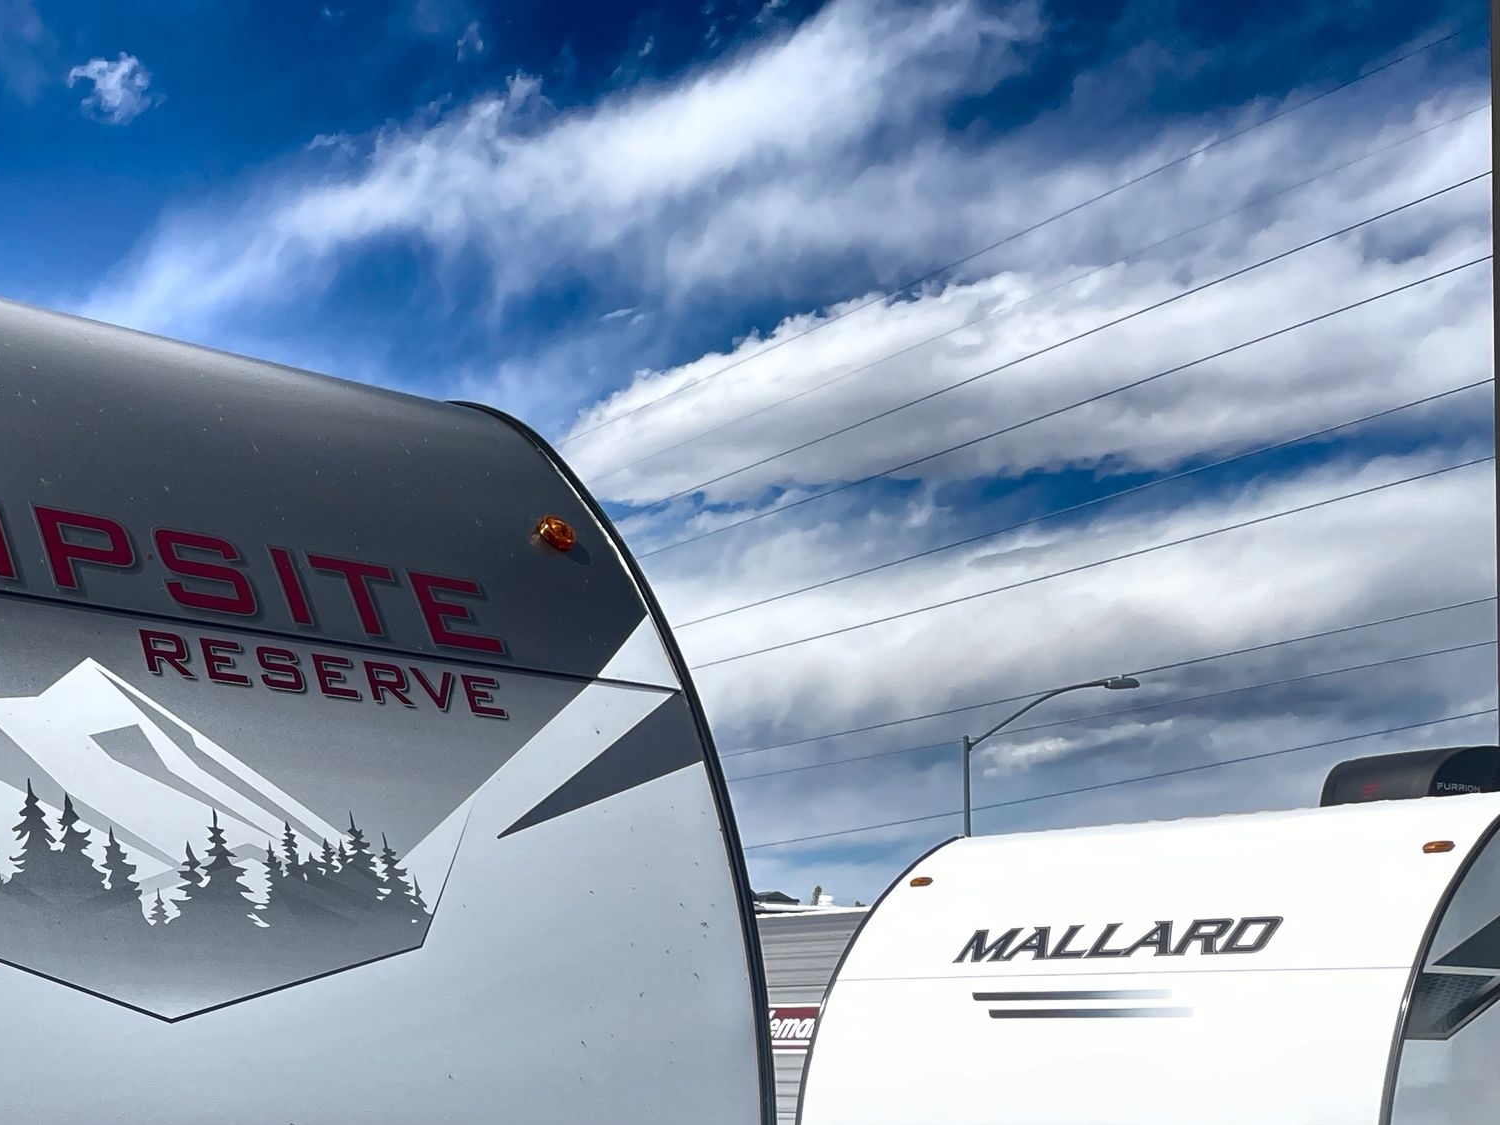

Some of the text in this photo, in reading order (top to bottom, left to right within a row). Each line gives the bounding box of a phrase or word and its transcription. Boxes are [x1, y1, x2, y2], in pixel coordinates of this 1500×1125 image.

[138, 628, 509, 720] RESERVE
[1436, 782, 1482, 793] FURRION
[952, 916, 1284, 963] MALLARD
